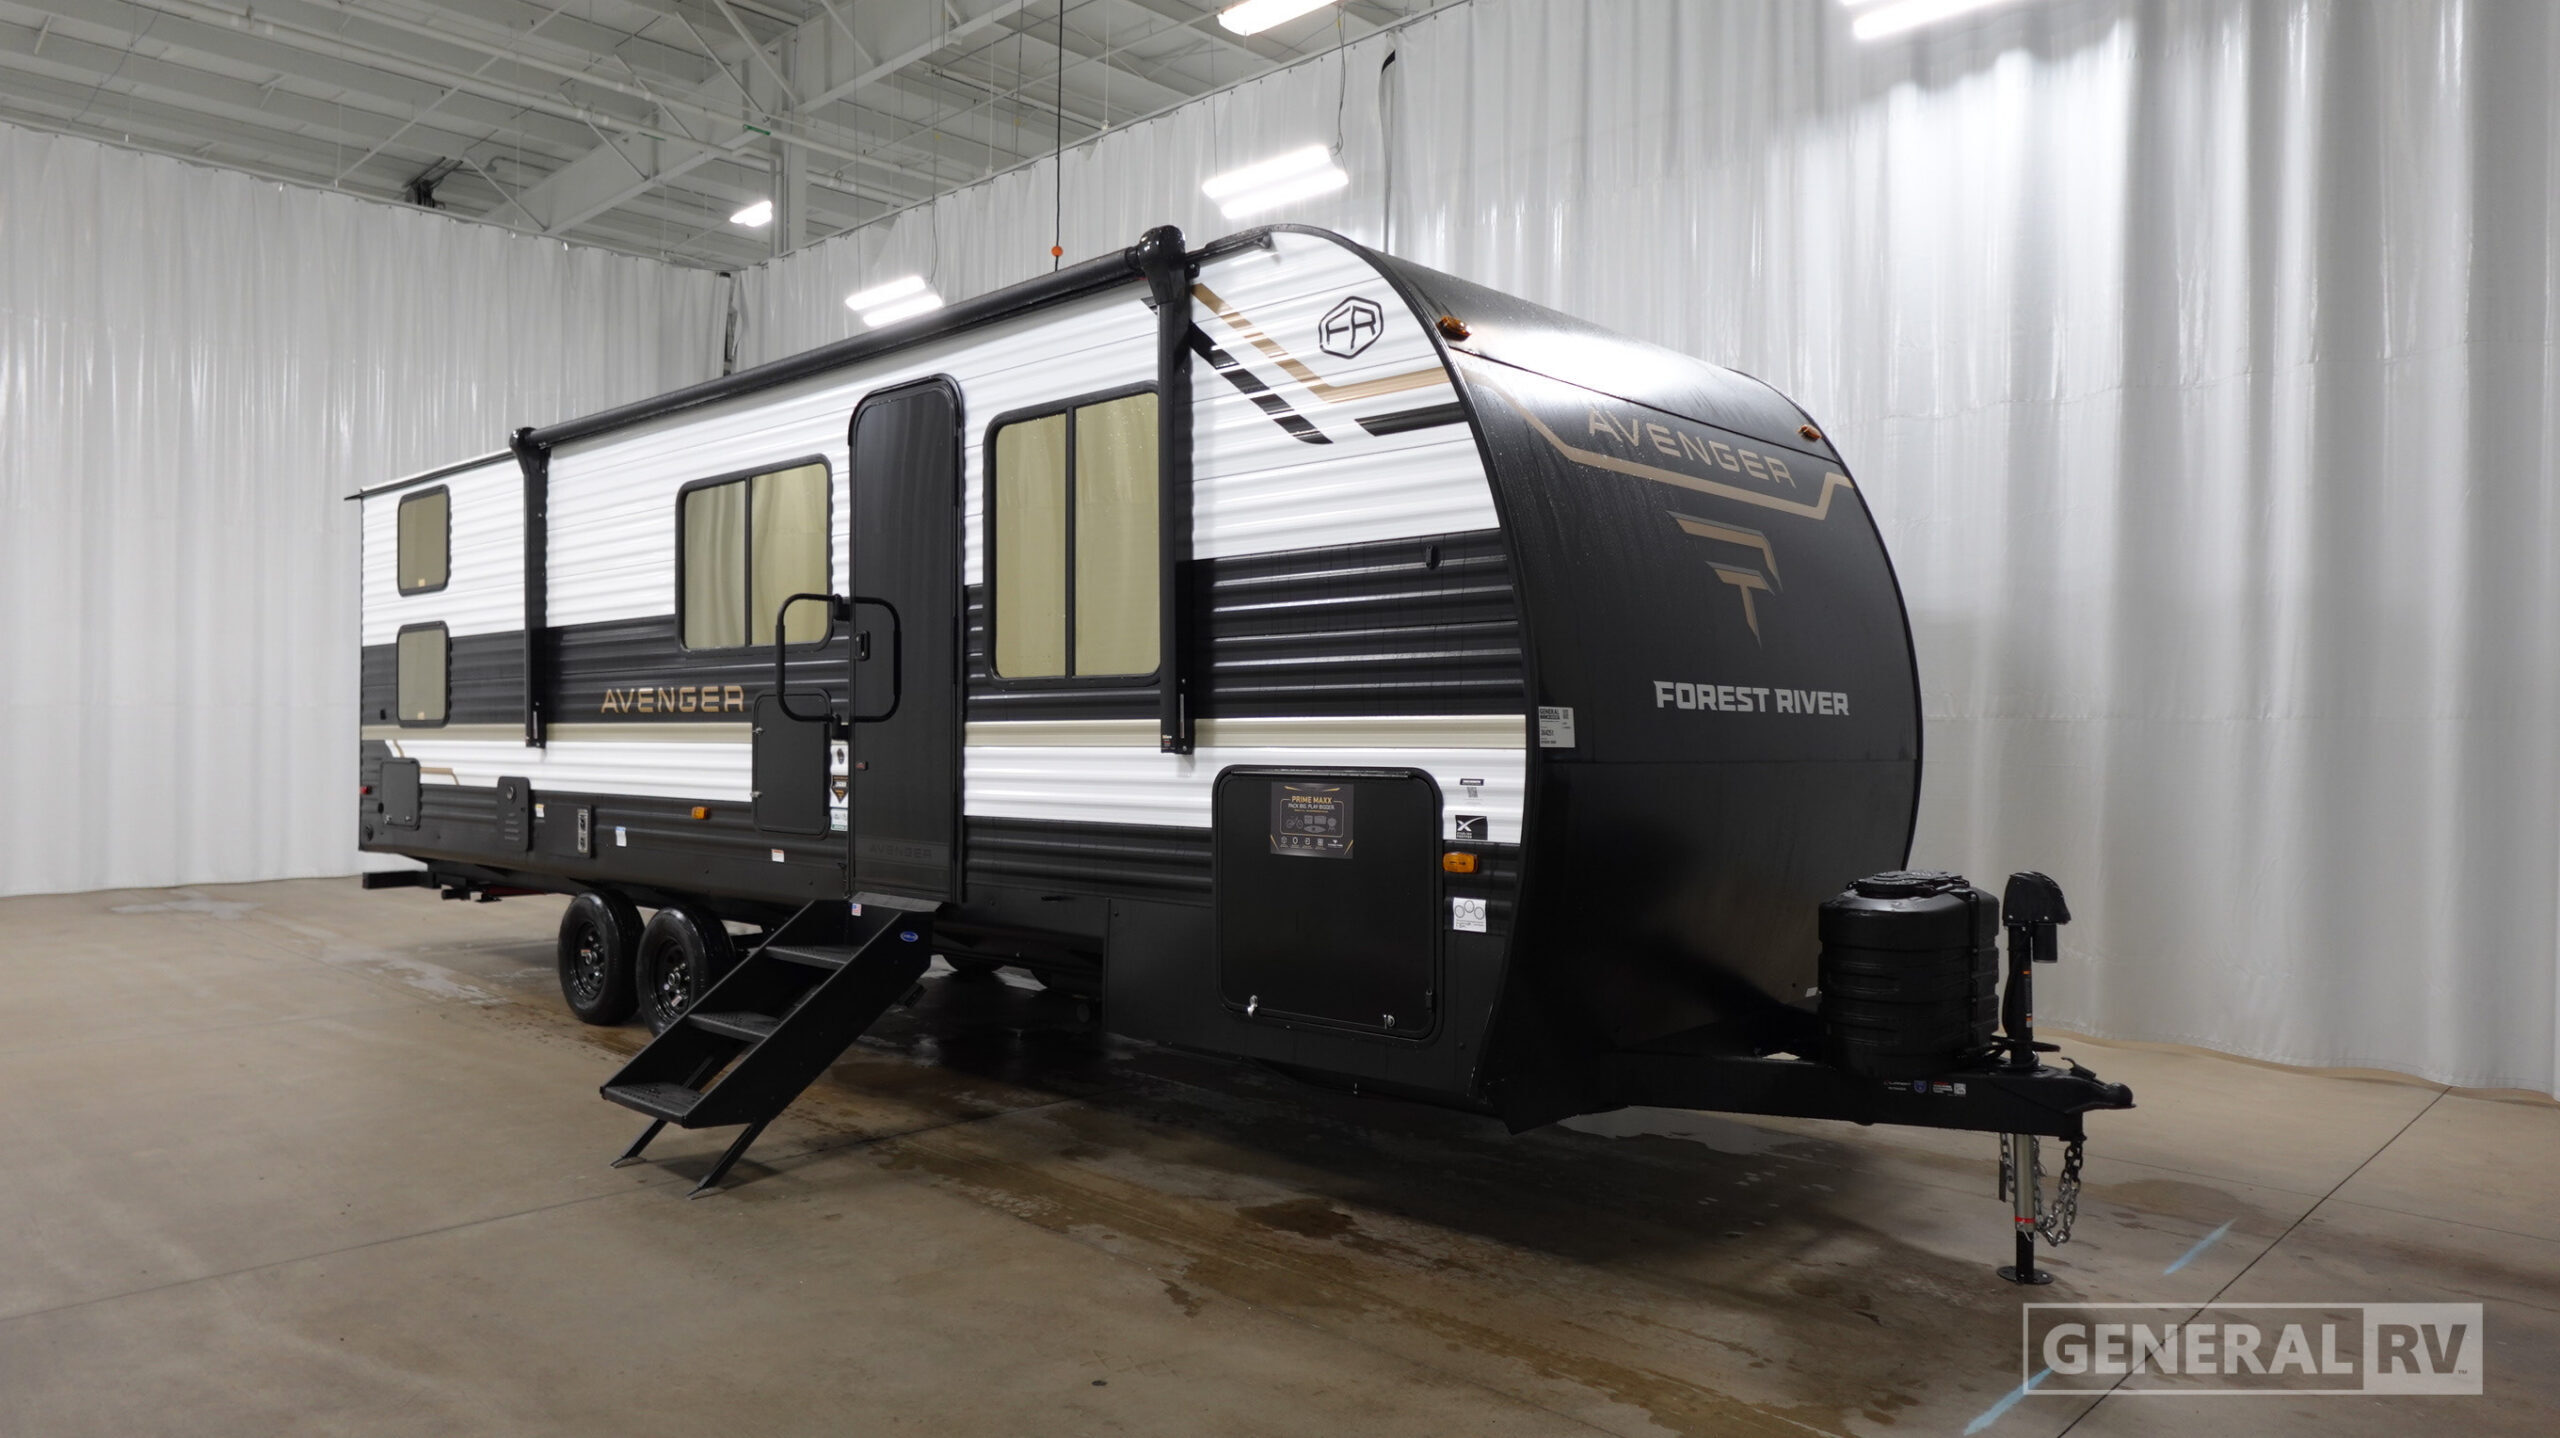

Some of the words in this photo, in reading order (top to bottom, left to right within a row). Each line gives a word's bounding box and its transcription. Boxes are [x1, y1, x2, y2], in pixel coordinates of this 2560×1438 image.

[1588, 407, 1797, 489] AVENGER
[601, 685, 744, 713] AVENGER
[1653, 680, 1770, 713] FOREST
[1774, 688, 1850, 716] RIVER
[1291, 796, 1312, 804] PRIME
[1312, 796, 1333, 805] MAXX
[868, 843, 932, 859] AVENGER
